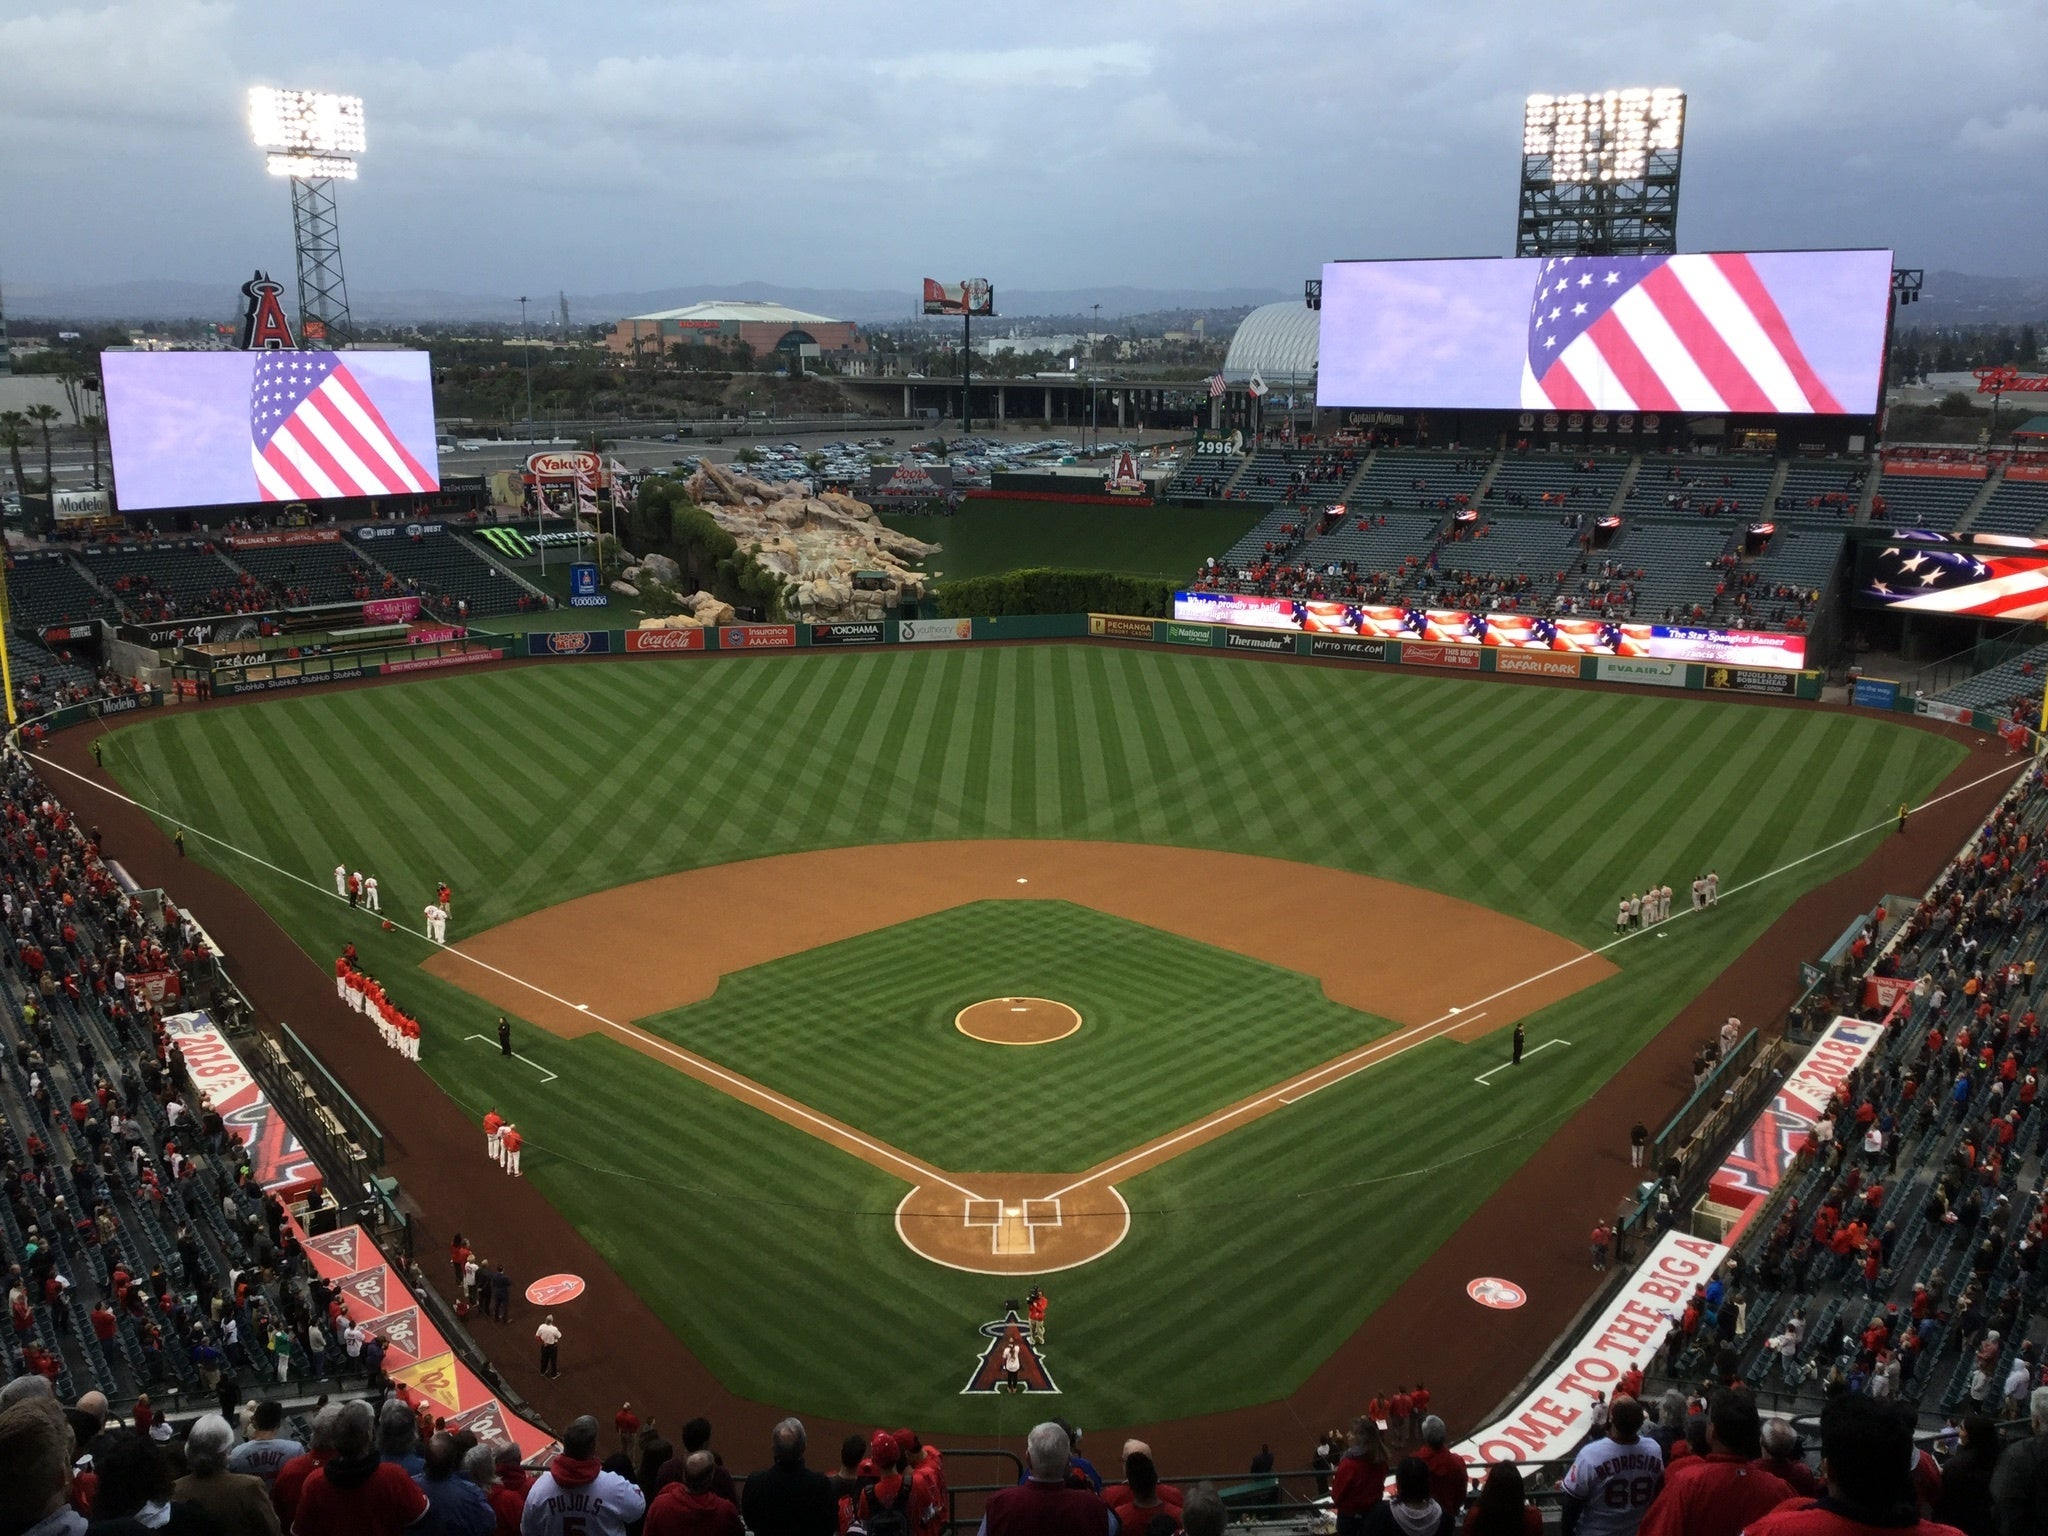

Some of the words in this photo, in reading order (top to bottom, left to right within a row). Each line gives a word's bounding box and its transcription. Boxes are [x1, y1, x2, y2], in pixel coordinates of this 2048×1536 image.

[1349, 411, 1375, 425] Captain
[1375, 412, 1404, 425] Morgan
[1197, 441, 1232, 454] 2996
[541, 458, 590, 471] Yakult
[893, 465, 928, 479] Coors
[60, 496, 103, 513] Modelo
[376, 528, 396, 537] WEST
[423, 524, 442, 533] WEST
[1218, 600, 1247, 611] proudly
[831, 624, 878, 635] YOKOHAMA
[1107, 620, 1152, 631] PECHANGA
[748, 628, 788, 636] Insurance
[1178, 628, 1210, 638] National
[637, 630, 692, 649] Coca-Cola
[748, 637, 789, 646] AAA.com
[1228, 634, 1283, 649] Thermador
[1669, 630, 1686, 639] The
[1688, 631, 1707, 641] Star
[1708, 633, 1750, 646] Spangled
[1752, 636, 1786, 647] Banner
[1314, 641, 1341, 651] NITTO
[1342, 643, 1384, 655] TIRE.COM
[1444, 648, 1459, 656] THIS
[1459, 649, 1480, 658] BUD'S
[469, 653, 493, 662] BASEBALL
[1444, 655, 1457, 663] FOR
[1680, 650, 1715, 660] Francis
[1500, 659, 1541, 671] SAFARI
[1543, 662, 1575, 674] PARK
[1607, 664, 1633, 673] EVA
[1632, 666, 1658, 675] AIR
[300, 674, 330, 684] StubHub
[333, 670, 362, 680] StubHub
[1737, 671, 1766, 679] PUJOLS
[267, 679, 298, 688] StubHub
[1736, 677, 1788, 687] BOBBLEHEAD
[234, 683, 265, 693] StubHub
[102, 696, 136, 714] Modelo
[174, 1033, 240, 1078] 2018
[1798, 1040, 1864, 1088] 2018
[1556, 1357, 1620, 1400] TO
[1593, 1299, 1667, 1358] THE
[1637, 1255, 1701, 1304] BIG
[1673, 1238, 1717, 1260] A
[547, 1494, 603, 1516] PUJOLS
